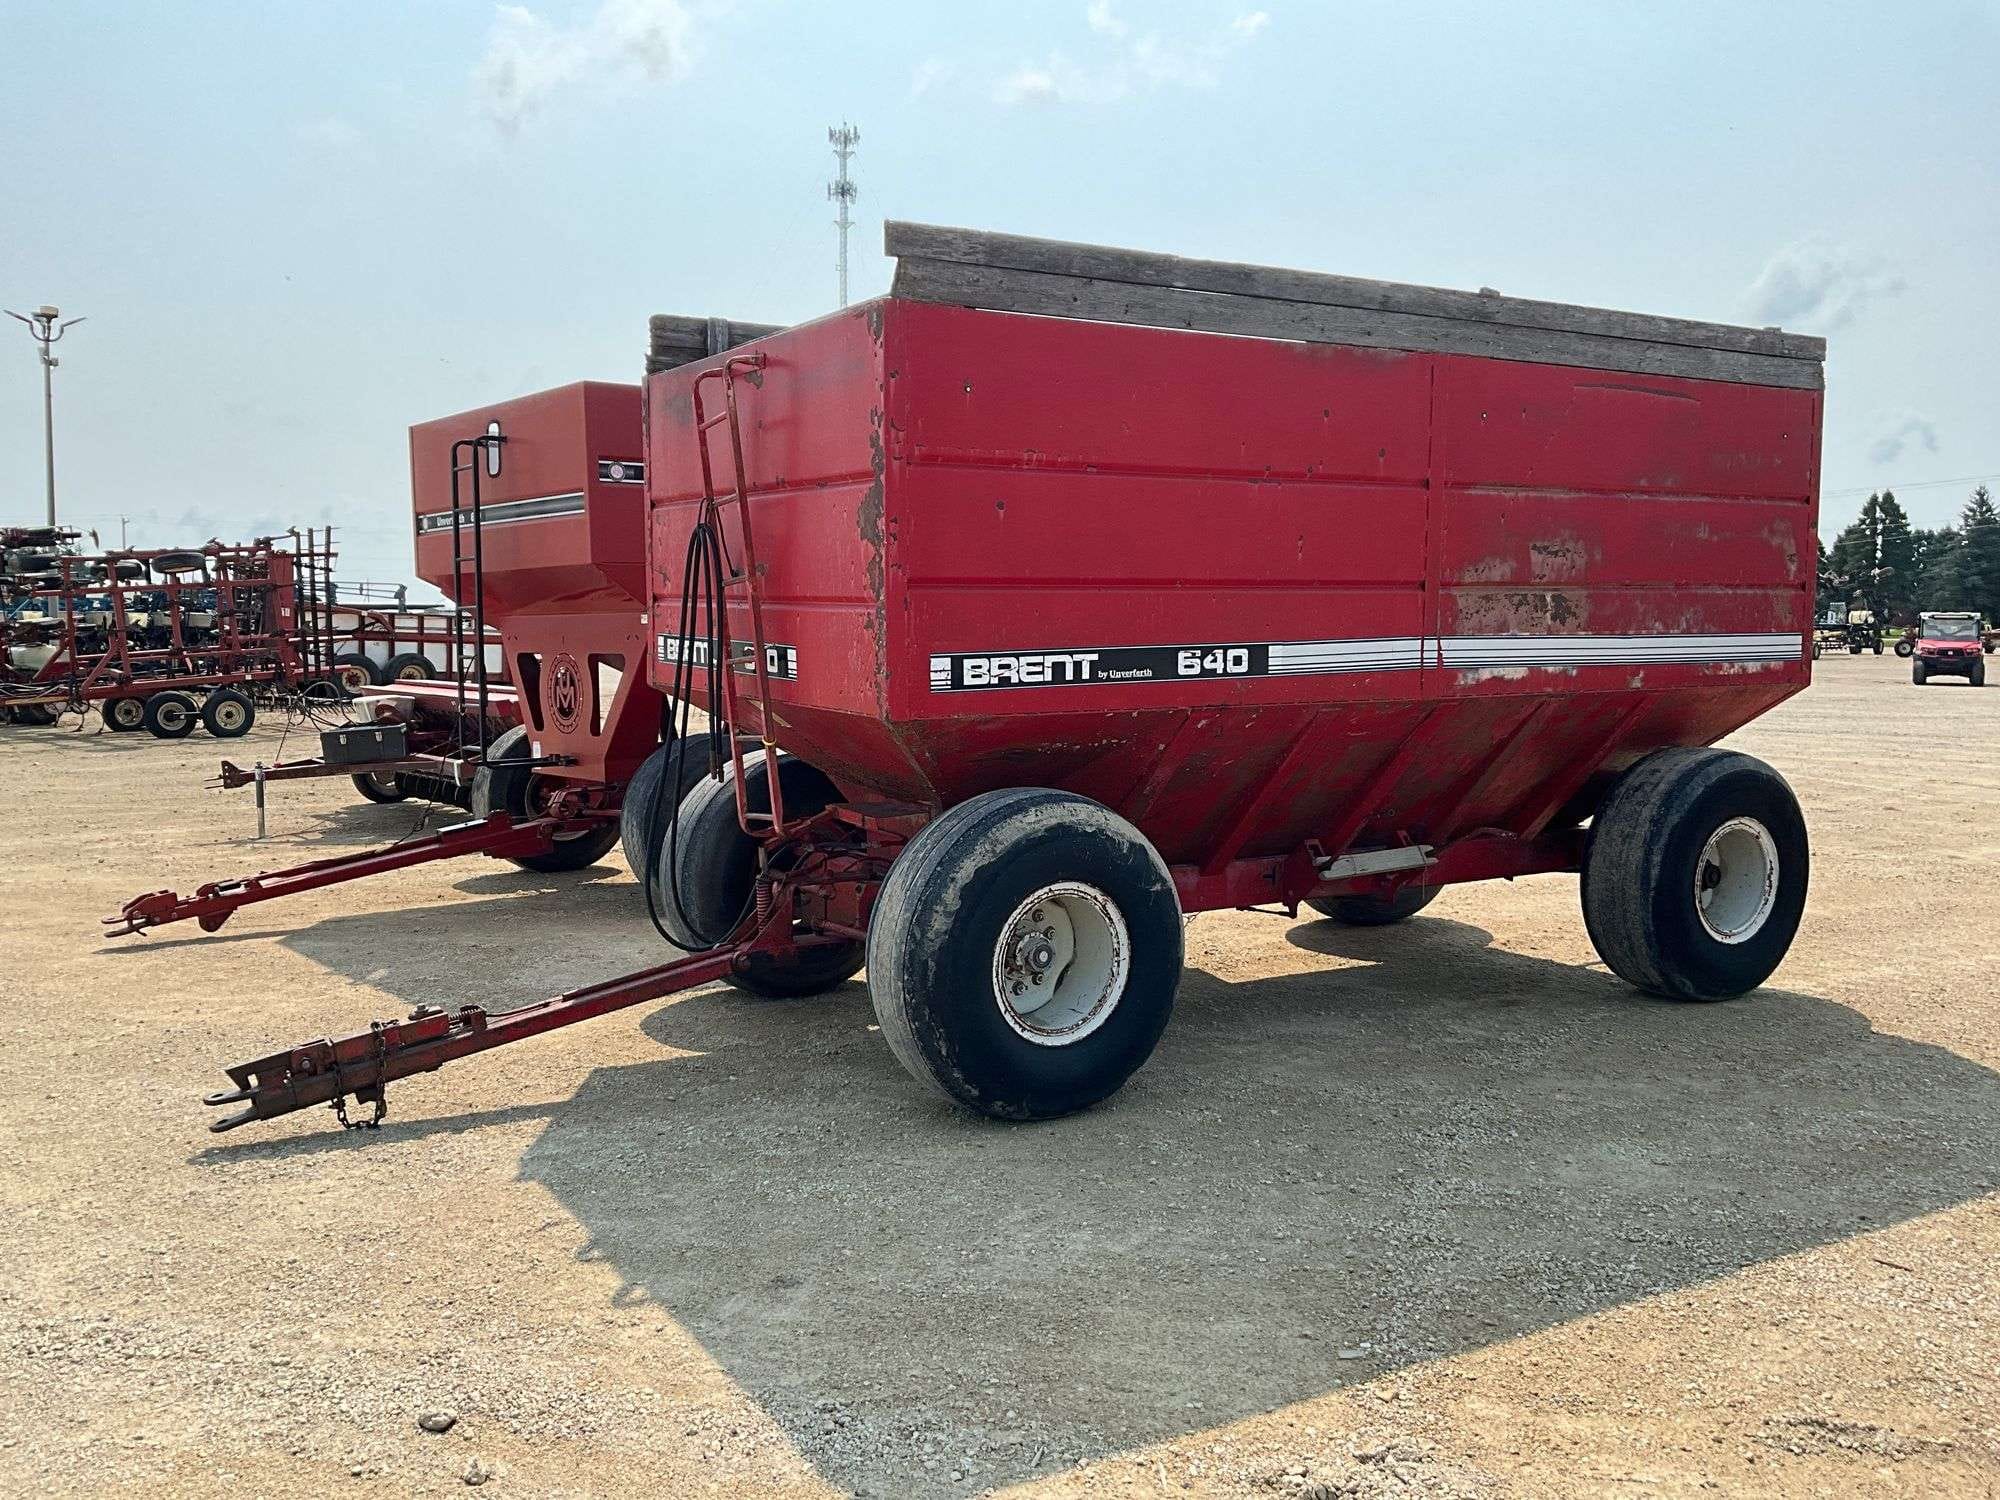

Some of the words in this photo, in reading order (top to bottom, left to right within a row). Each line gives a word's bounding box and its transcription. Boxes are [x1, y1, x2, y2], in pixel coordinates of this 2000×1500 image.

[963, 653, 1099, 686] BRENT
[1097, 670, 1108, 680] by
[1109, 668, 1153, 679] Unverferth
[1177, 648, 1249, 676] 640
